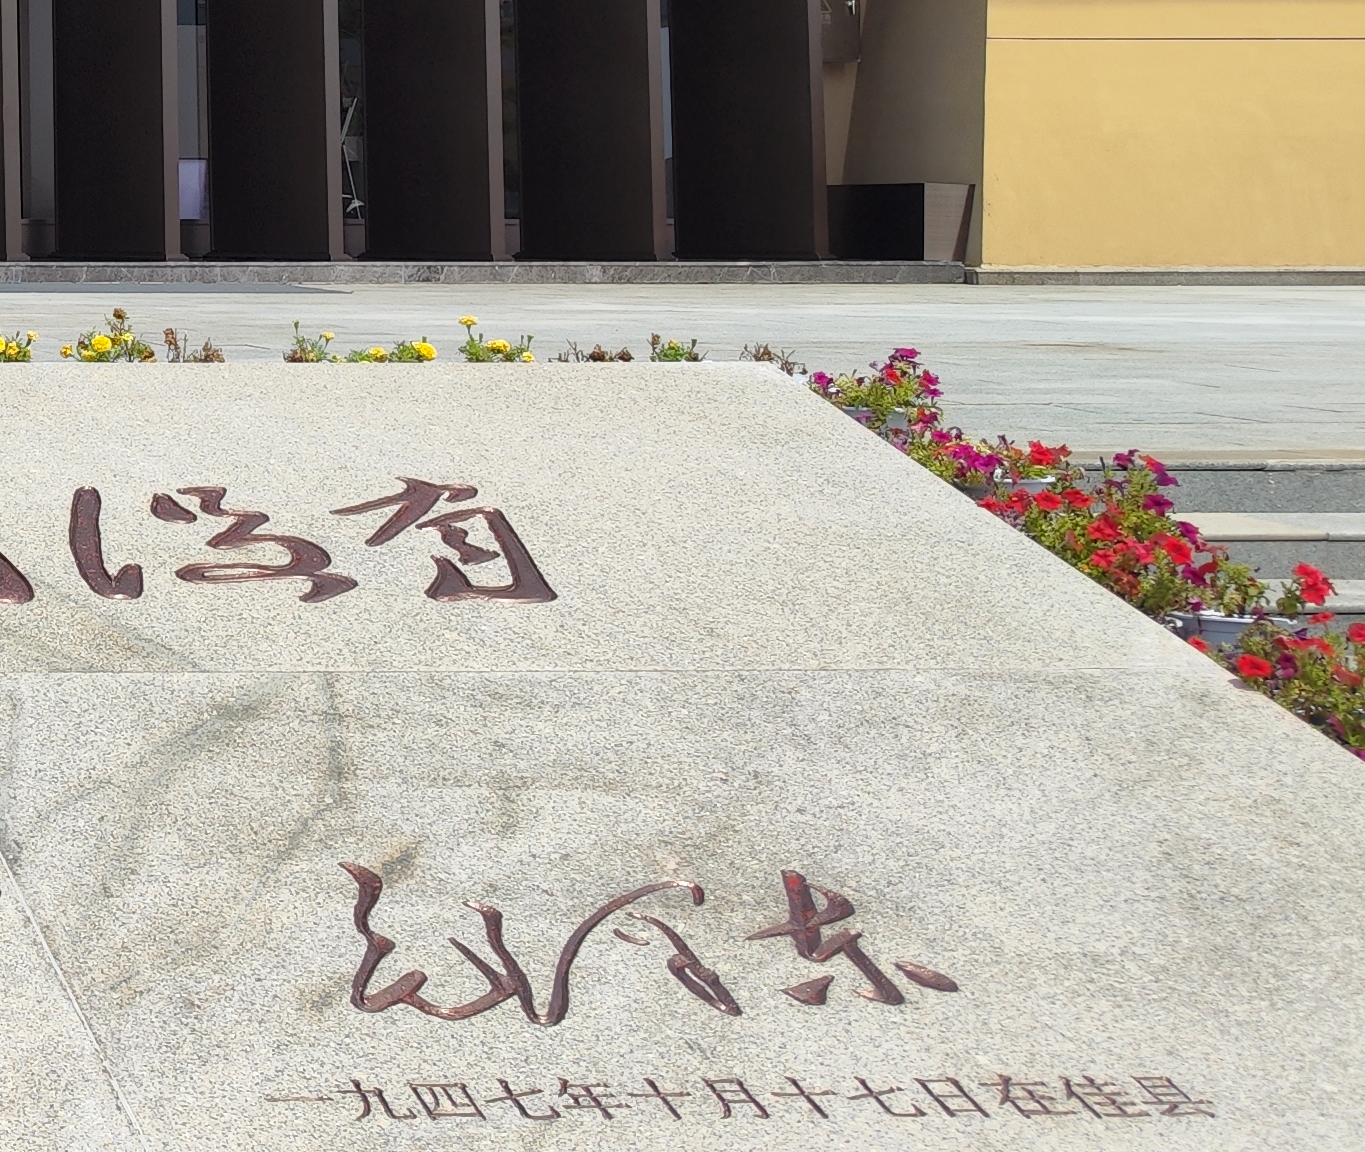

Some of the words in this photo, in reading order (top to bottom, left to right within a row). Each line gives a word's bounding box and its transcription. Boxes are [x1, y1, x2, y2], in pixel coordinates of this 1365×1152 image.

[266, 1074, 1215, 1123] 一九四七年十月十七日在佳县
